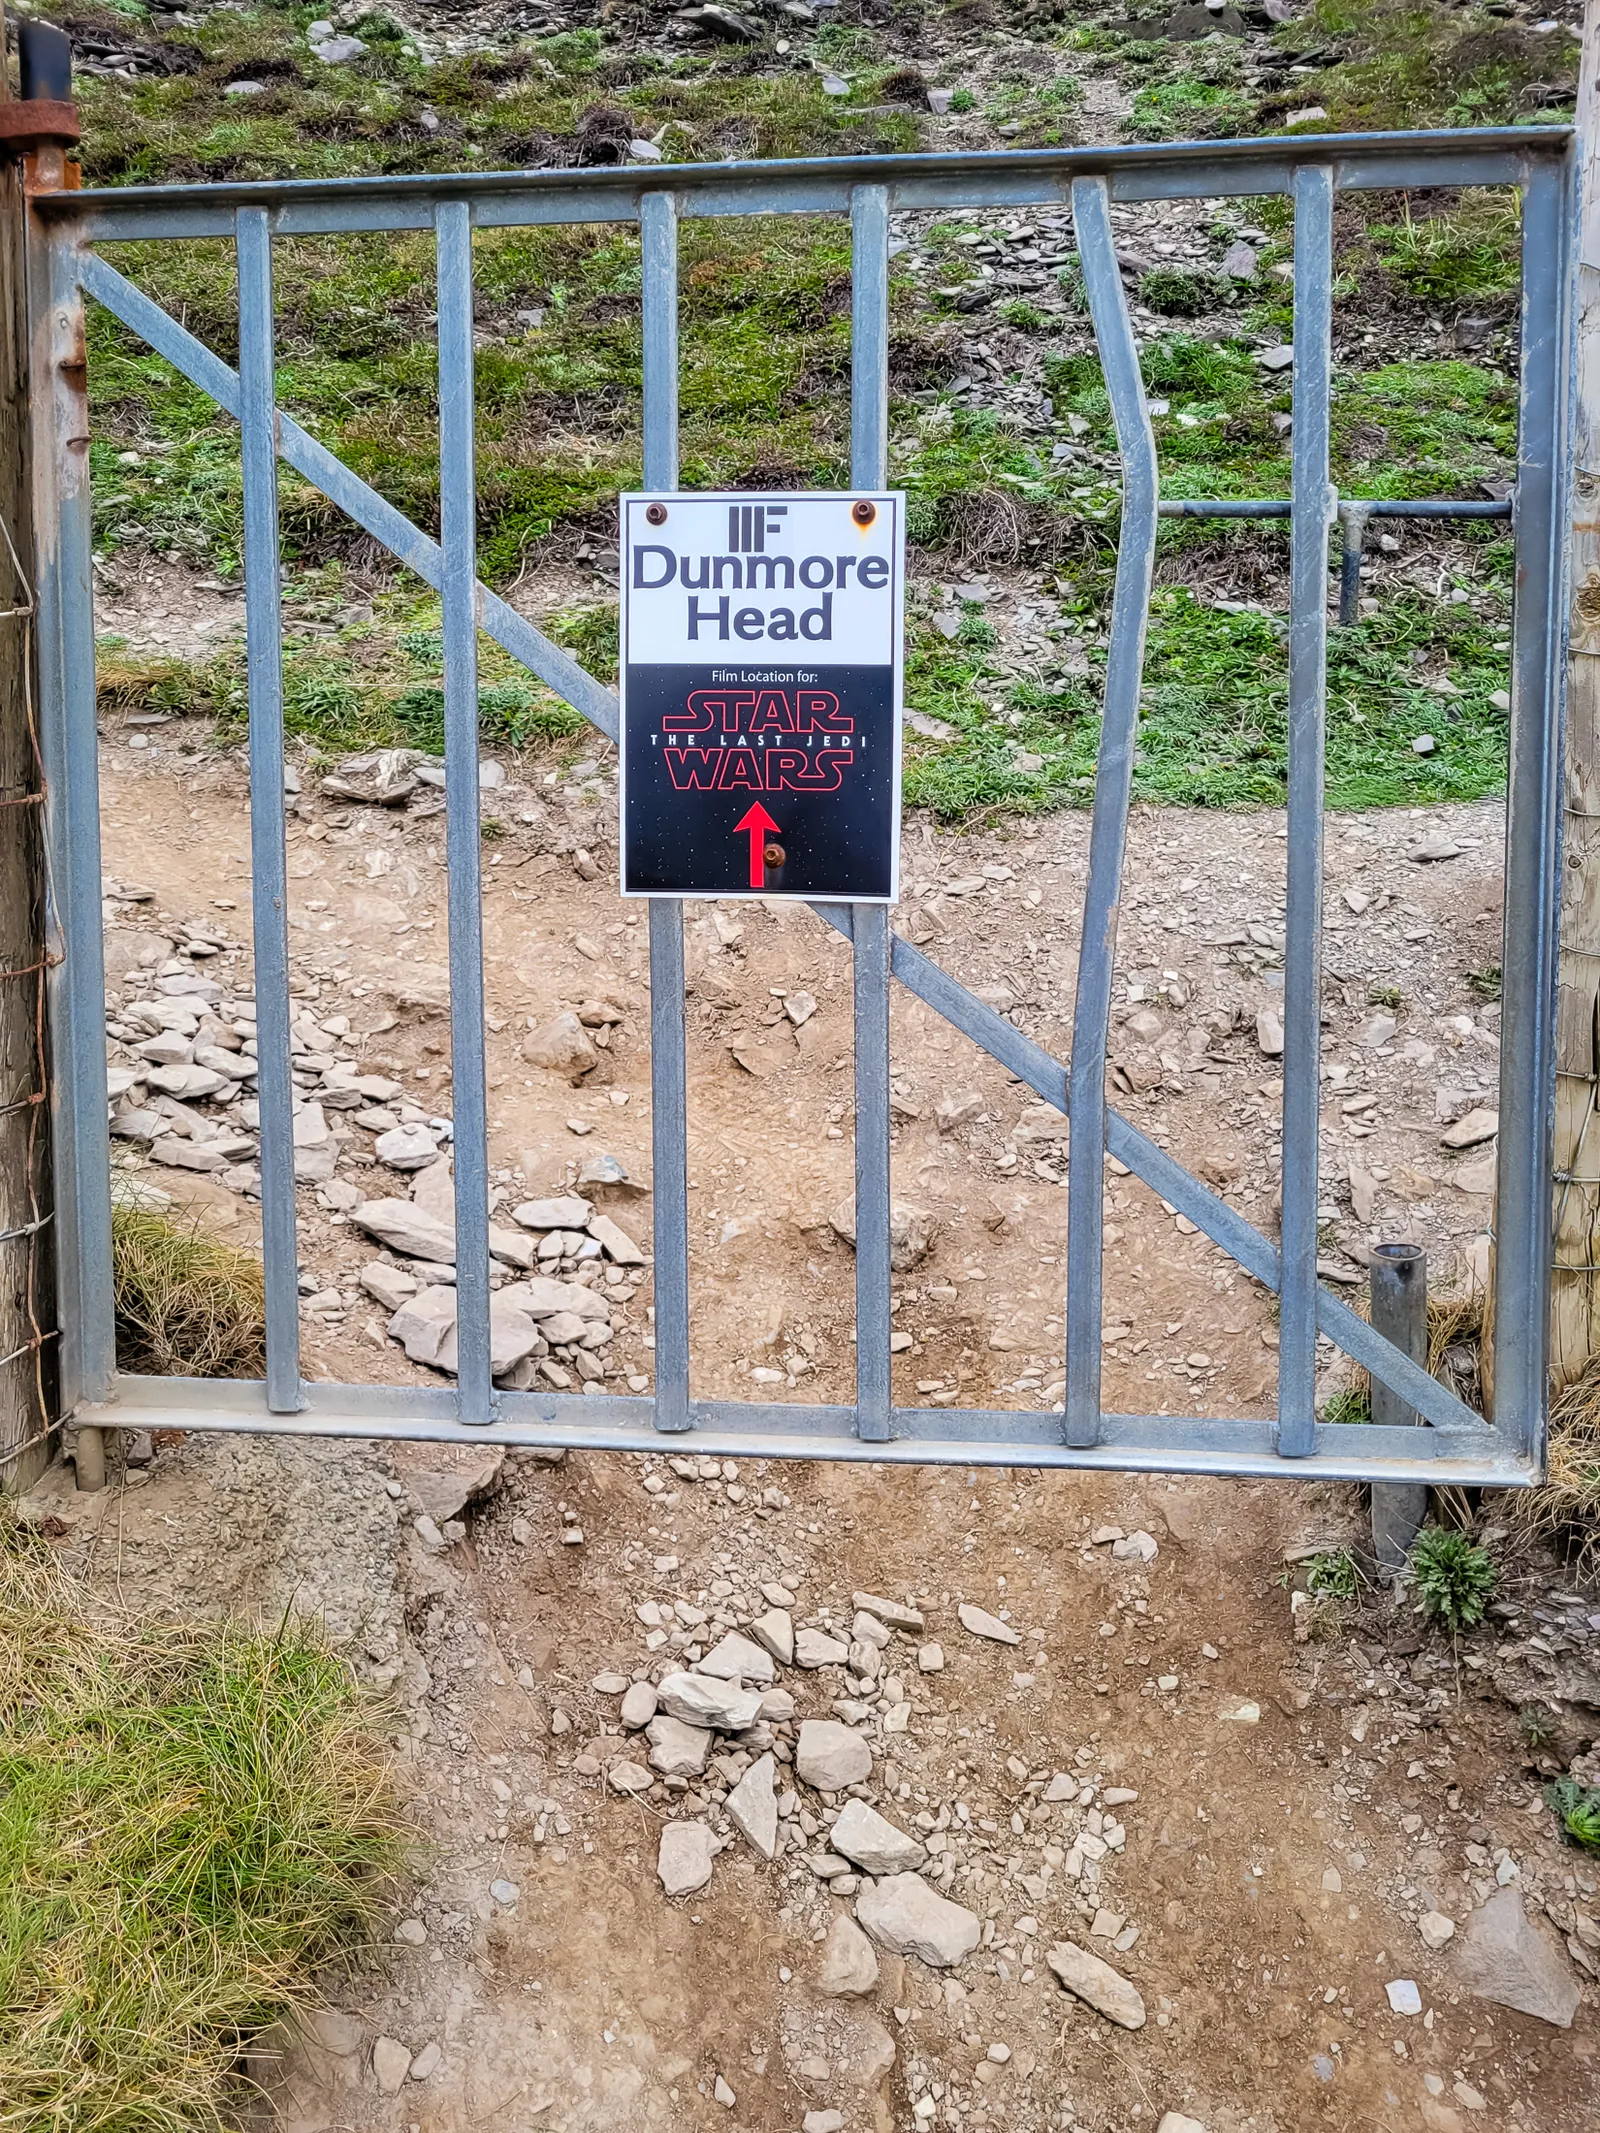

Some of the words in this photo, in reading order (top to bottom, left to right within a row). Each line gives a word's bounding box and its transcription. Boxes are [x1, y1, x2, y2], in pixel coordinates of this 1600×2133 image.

[633, 545, 889, 589] Dunmore
[687, 592, 833, 640] Head
[712, 670, 738, 683] Film
[741, 670, 794, 682] Location
[796, 670, 818, 683] for:
[663, 690, 854, 733] STAR
[651, 734, 695, 746] THE
[720, 735, 782, 746] LAST
[806, 736, 866, 748] JEDI
[664, 748, 853, 791] WARS
